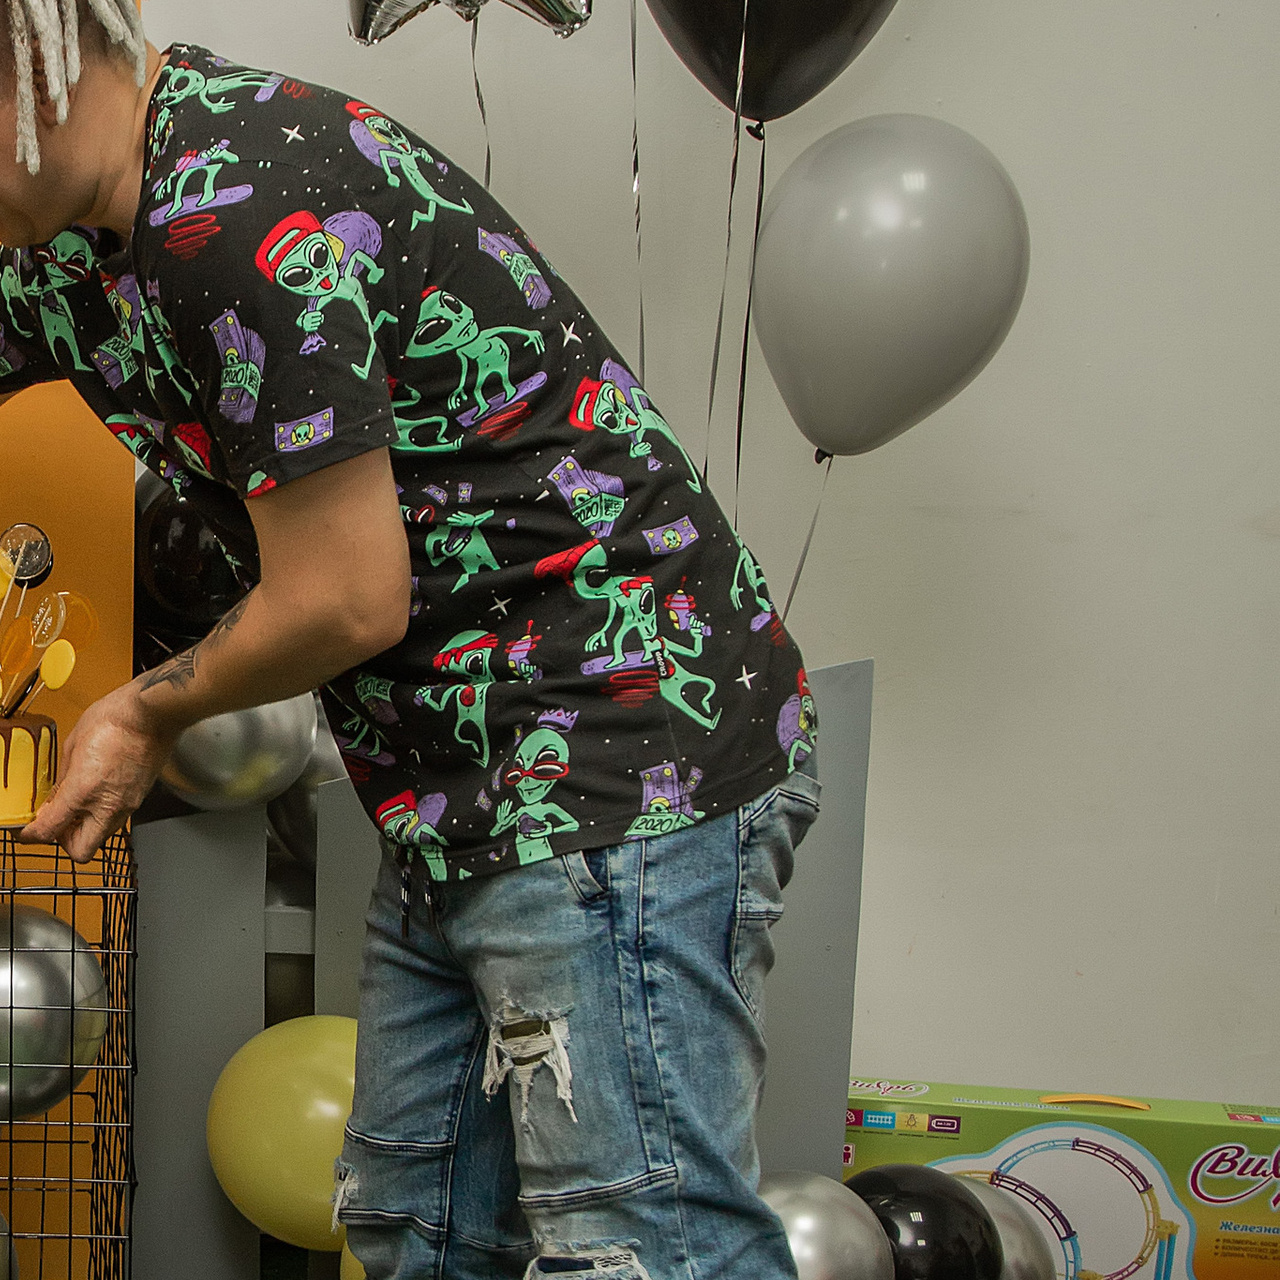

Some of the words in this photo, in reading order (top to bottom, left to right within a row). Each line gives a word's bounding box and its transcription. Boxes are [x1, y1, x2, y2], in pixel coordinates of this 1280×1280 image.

[224, 367, 245, 383] 2020
[655, 651, 667, 676] CROPP
[634, 817, 673, 833] 2020
